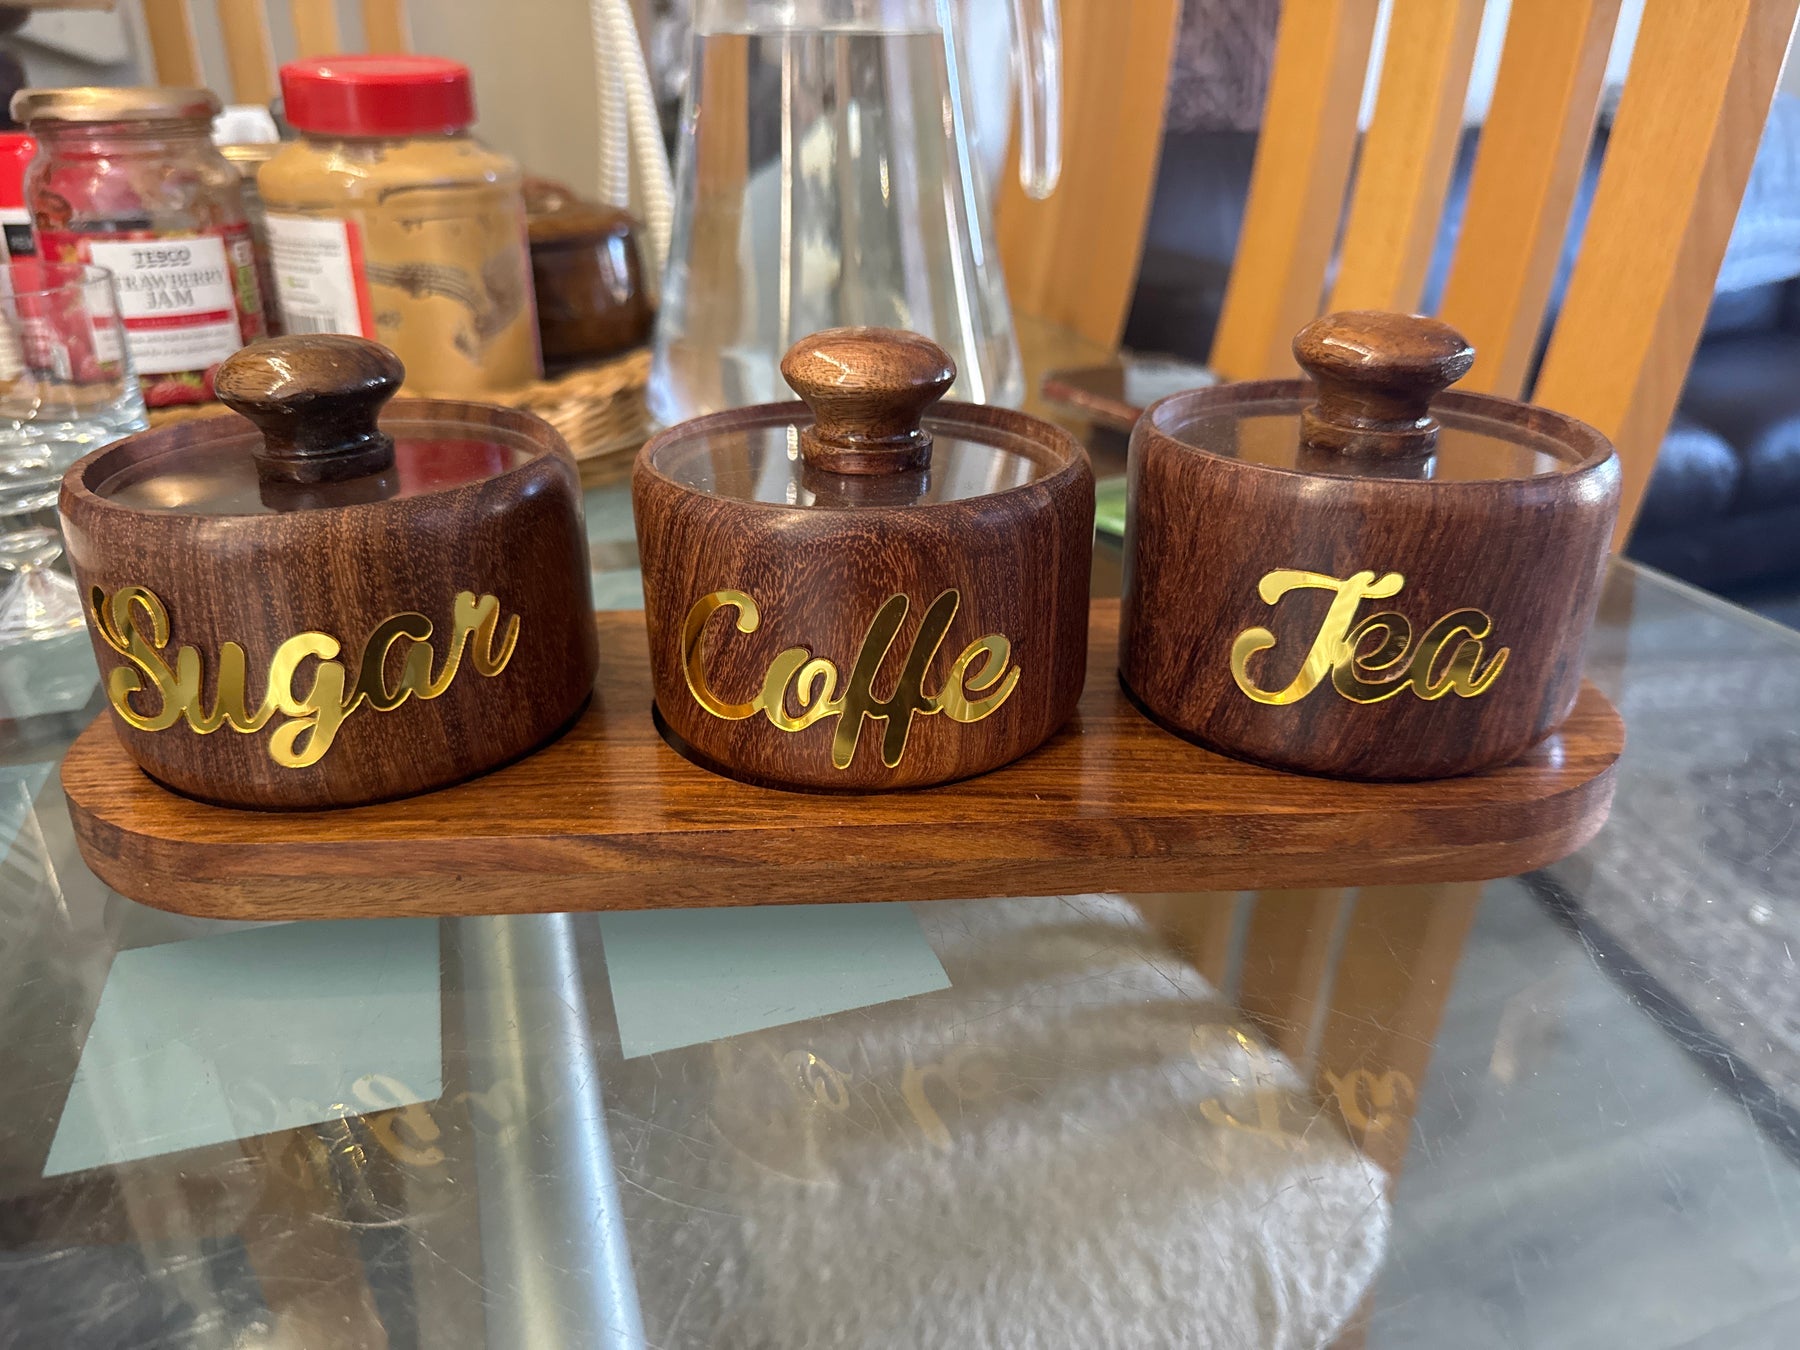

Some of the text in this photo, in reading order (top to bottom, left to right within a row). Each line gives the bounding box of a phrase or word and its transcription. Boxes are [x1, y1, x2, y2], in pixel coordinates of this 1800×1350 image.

[132, 248, 192, 268] TESCO
[147, 289, 195, 310] JAM
[90, 585, 520, 769] Sugar
[682, 588, 1021, 770] Coffe
[1230, 568, 1511, 706] Tea
